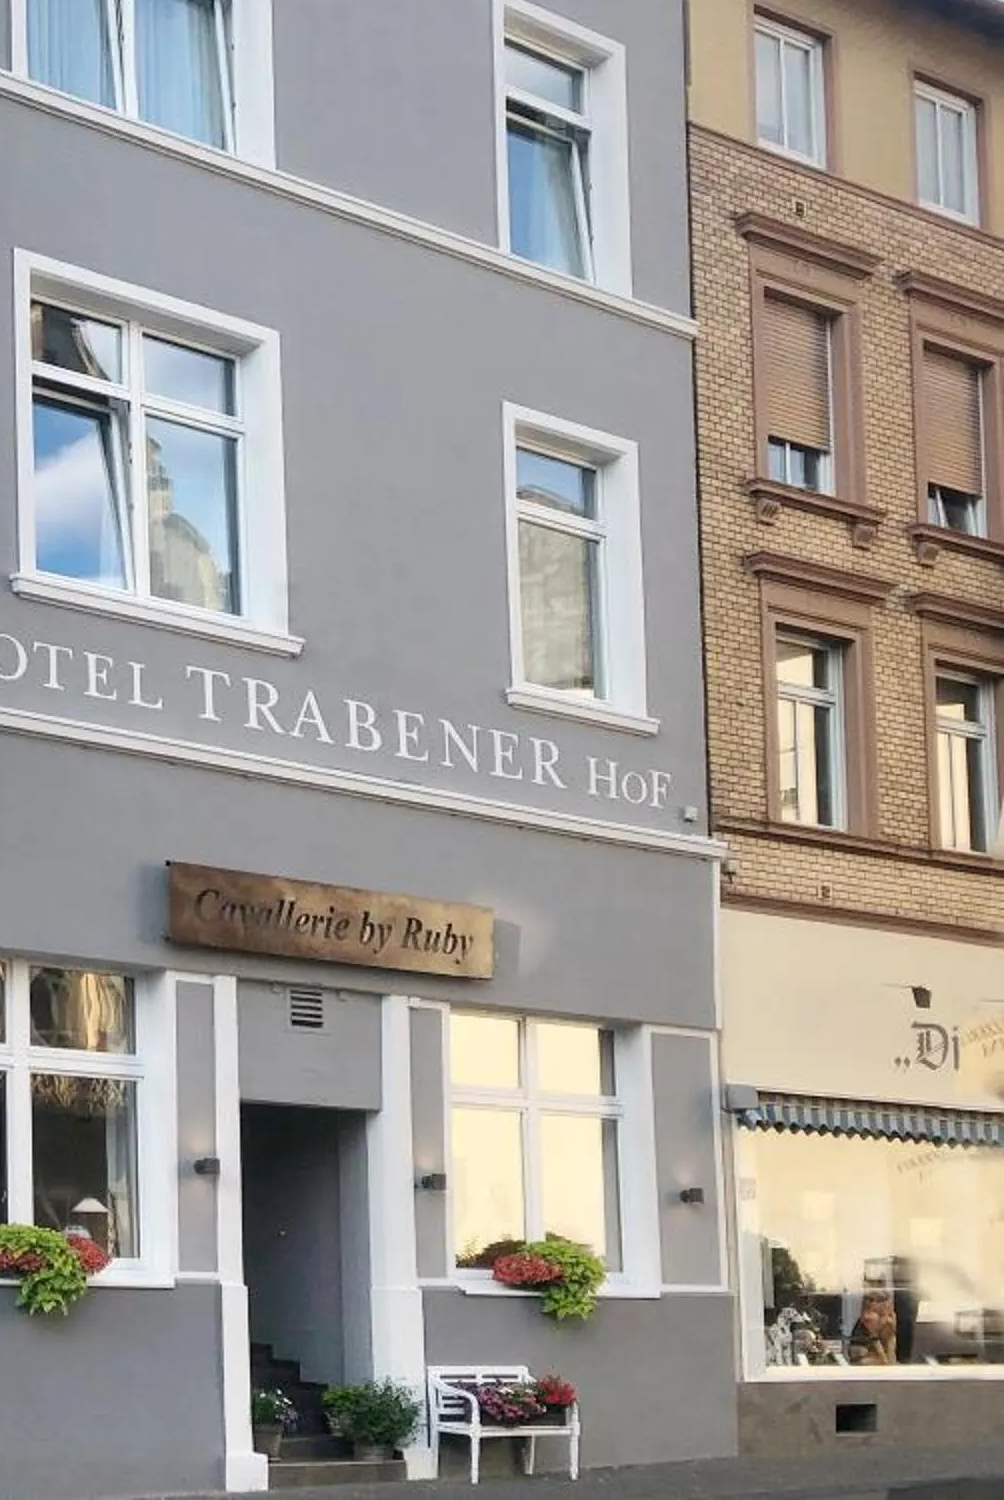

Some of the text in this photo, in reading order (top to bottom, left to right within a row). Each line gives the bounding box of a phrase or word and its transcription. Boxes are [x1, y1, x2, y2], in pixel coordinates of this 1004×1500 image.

[185, 665, 568, 790] TRABENER
[195, 888, 475, 964] Cavallerie by Ruby
